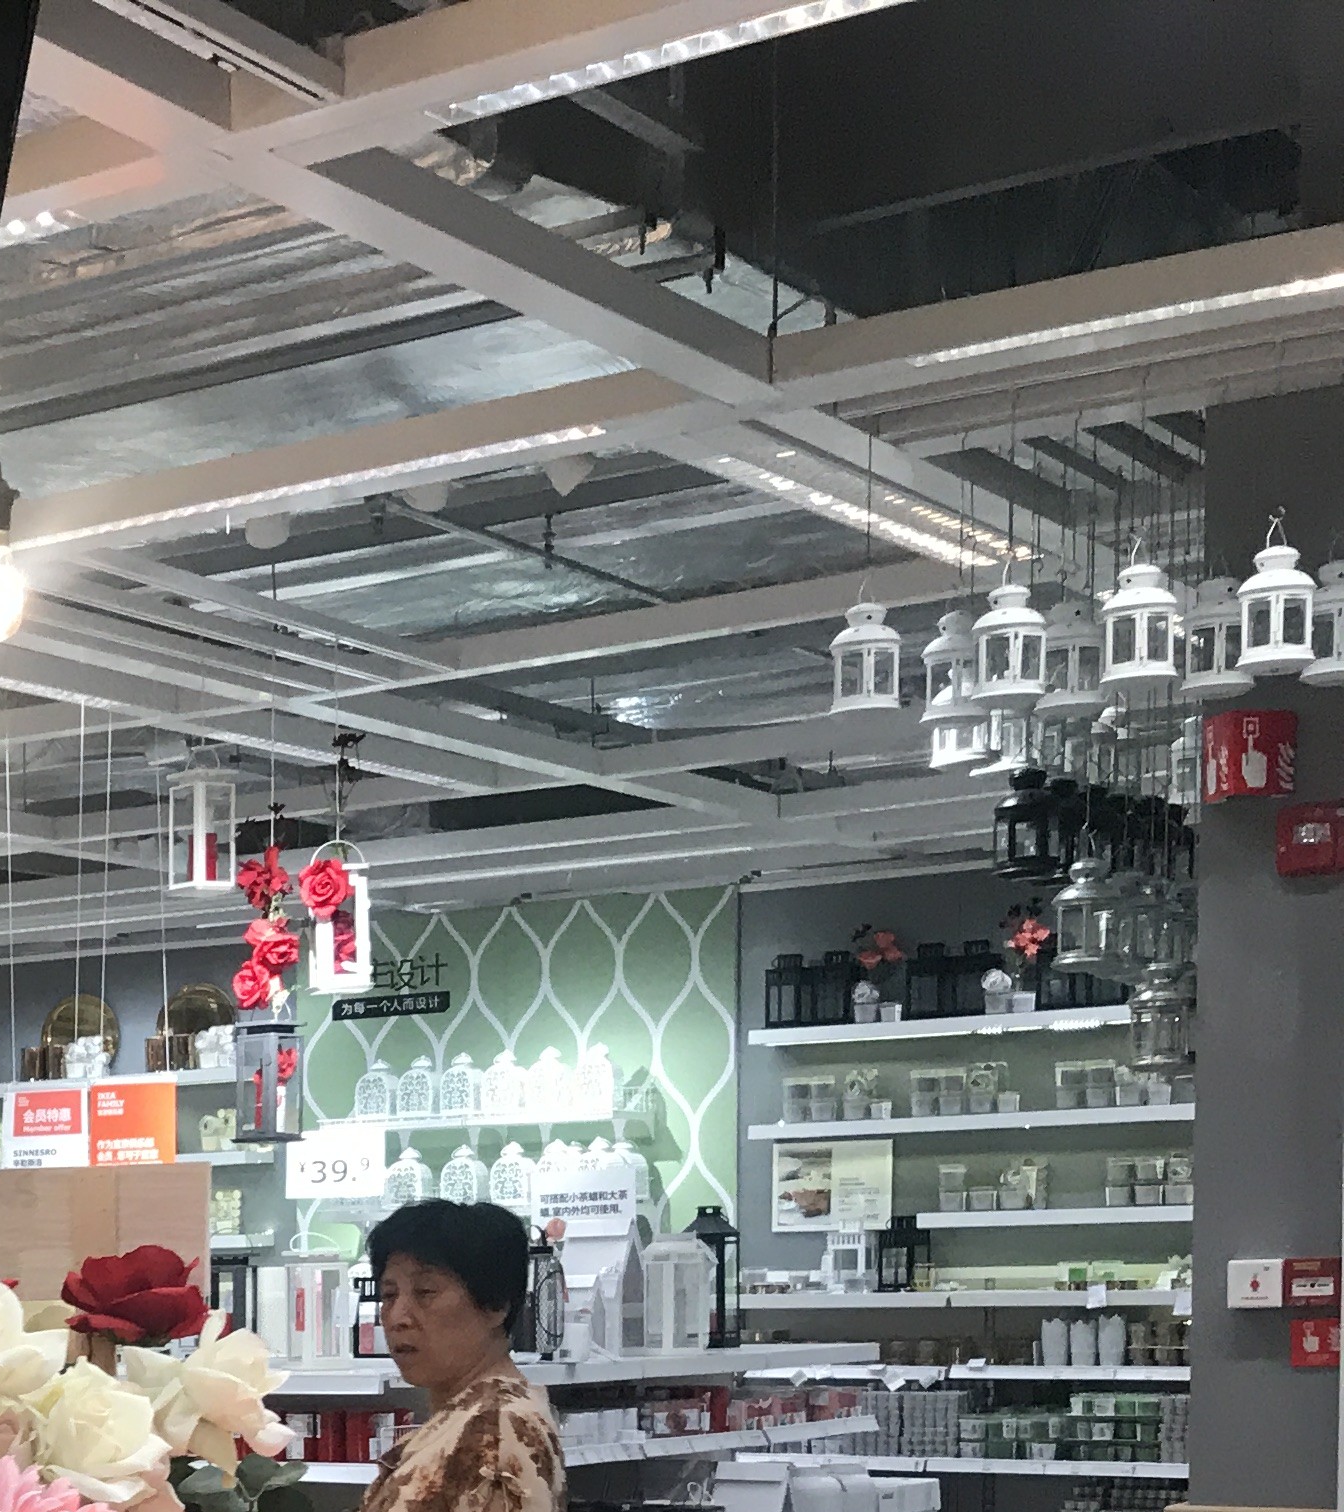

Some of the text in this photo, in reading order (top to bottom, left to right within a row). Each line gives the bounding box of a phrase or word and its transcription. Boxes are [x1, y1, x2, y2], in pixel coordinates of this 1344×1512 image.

[341, 996, 440, 1016] 为每一个人而设计
[23, 1108, 72, 1123] 会员特惠
[13, 1148, 57, 1157] SINNESRO
[299, 1157, 370, 1183] ¥39.9
